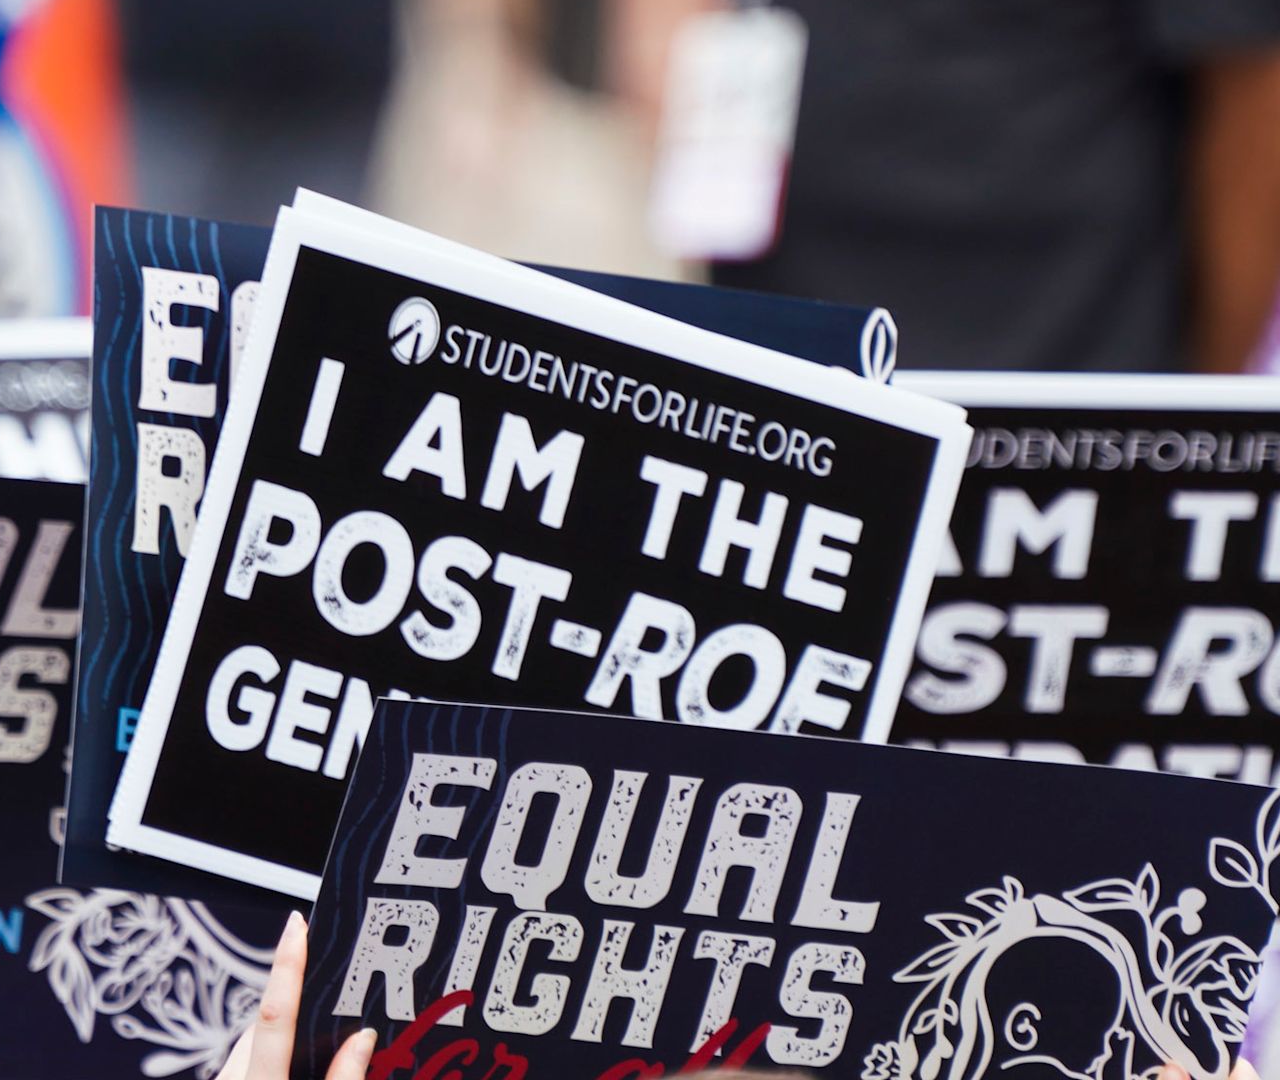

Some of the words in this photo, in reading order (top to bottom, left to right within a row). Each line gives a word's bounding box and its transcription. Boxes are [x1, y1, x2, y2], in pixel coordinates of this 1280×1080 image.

[299, 357, 346, 457] I
[382, 394, 585, 530] AM
[638, 454, 864, 613] THE
[440, 324, 838, 478] STUDENTSFORLIFE.ORG
[222, 479, 873, 738] POST-ROE
[372, 751, 882, 935] EQUAL
[331, 894, 867, 1068] RIGHTS
